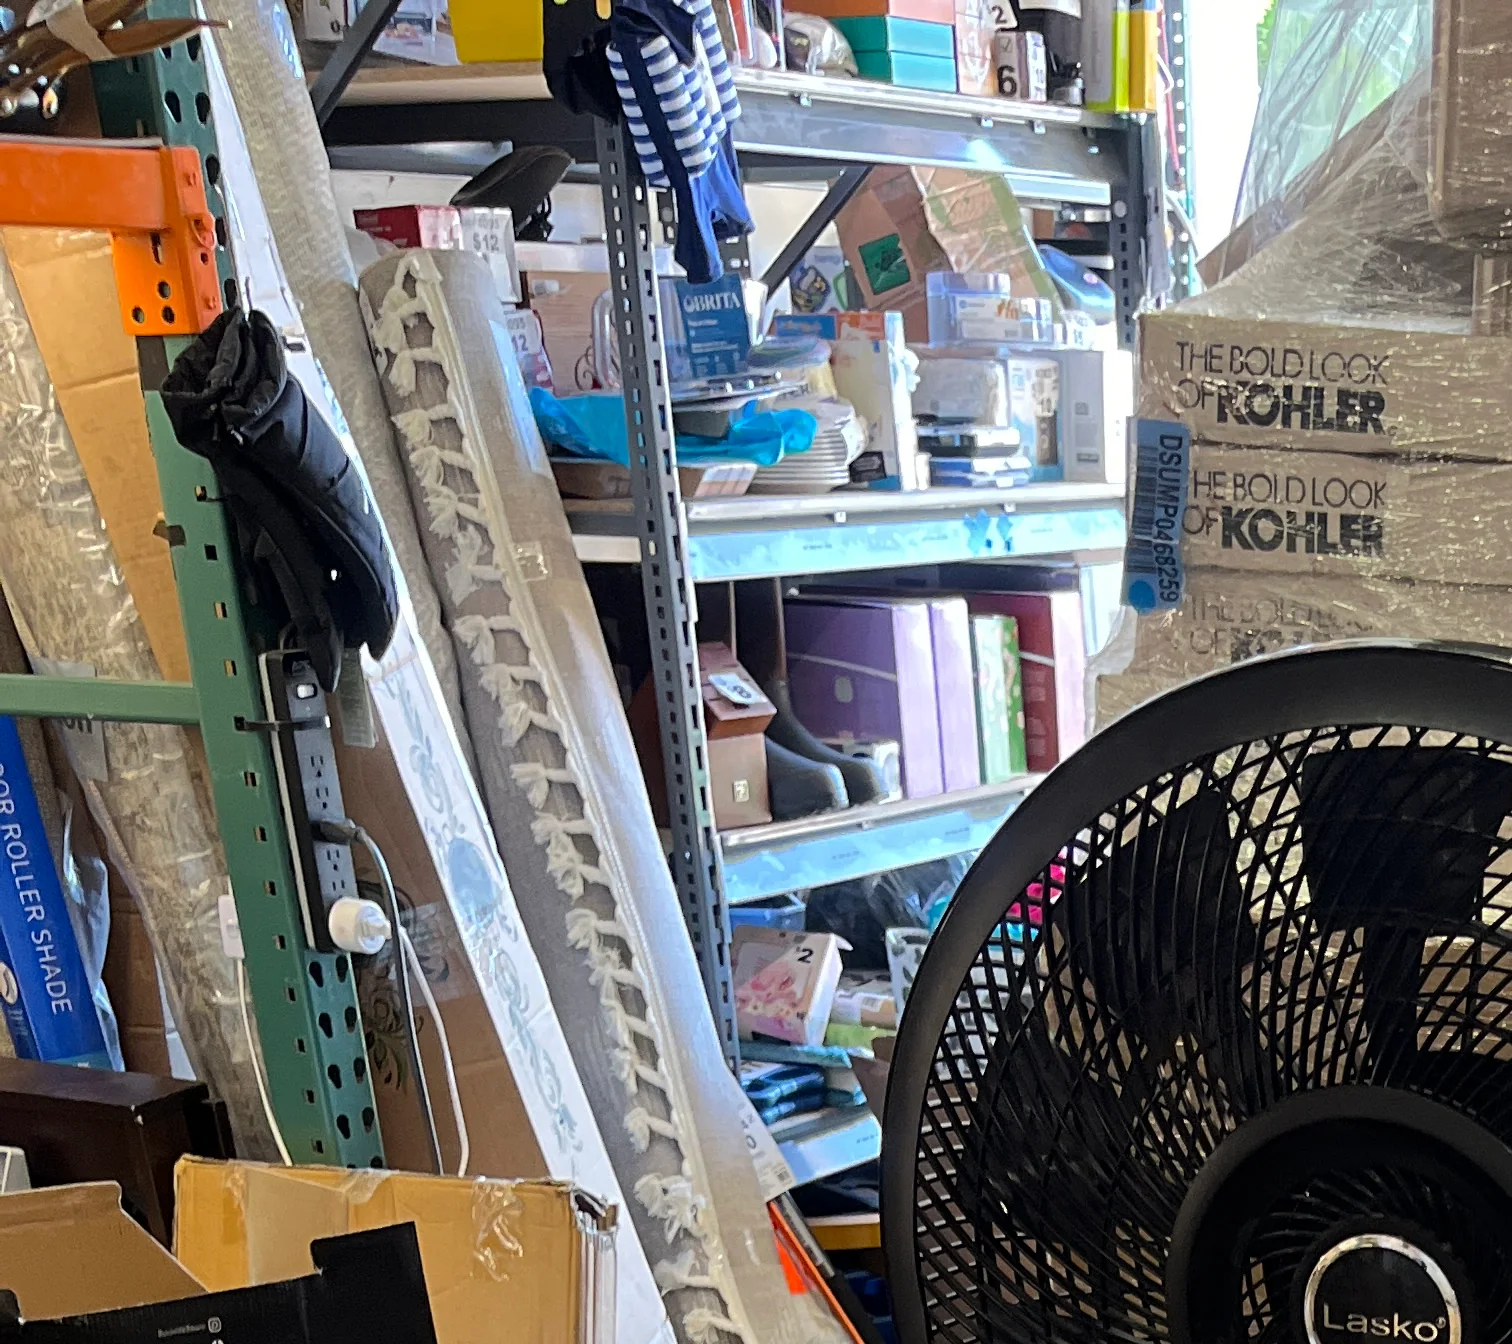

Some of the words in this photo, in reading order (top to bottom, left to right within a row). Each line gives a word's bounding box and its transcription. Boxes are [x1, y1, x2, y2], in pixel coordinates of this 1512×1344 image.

[1176, 341, 1224, 374] THE
[1229, 345, 1304, 380] BOLD
[1309, 351, 1390, 385] LOOK
[1177, 379, 1217, 409] OF
[1216, 381, 1386, 435] KOHLER
[1232, 472, 1306, 504] BOLD
[1311, 477, 1388, 509] LOOK
[1153, 433, 1183, 603] DSUMP0468259
[1181, 504, 1220, 535] OF
[1220, 506, 1385, 556] KOHLER
[3, 823, 45, 922] ROLLER
[31, 928, 73, 1016] SHADE
[1323, 1302, 1438, 1342] Lasko
